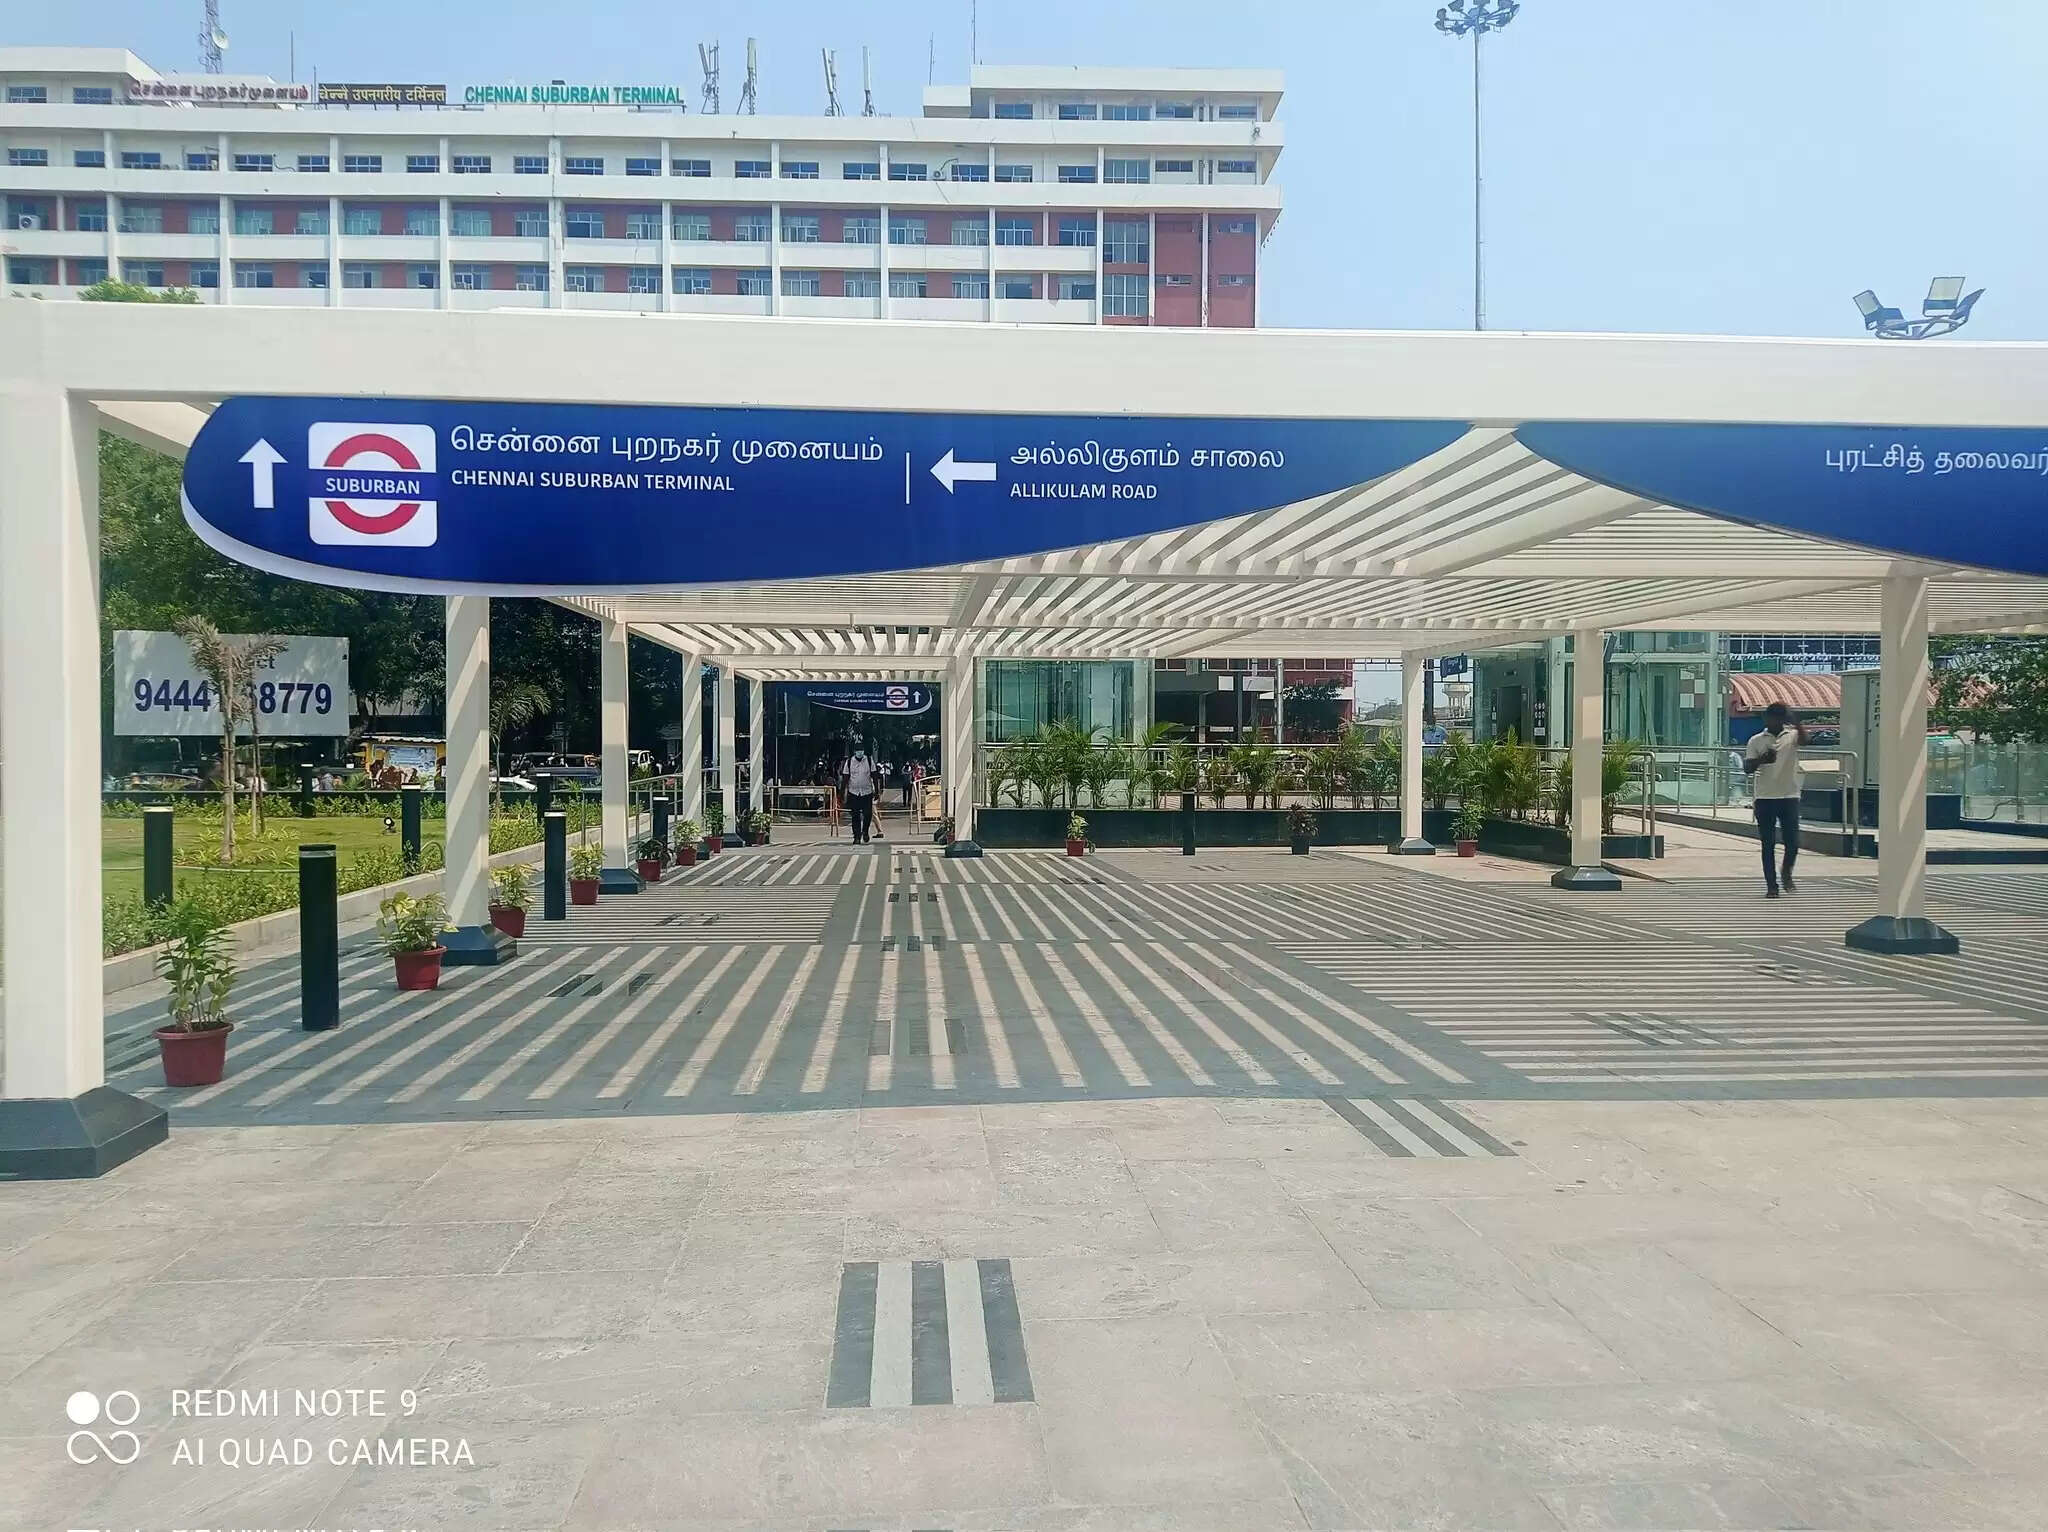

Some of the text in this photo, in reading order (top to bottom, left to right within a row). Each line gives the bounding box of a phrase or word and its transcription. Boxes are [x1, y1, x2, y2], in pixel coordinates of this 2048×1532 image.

[352, 86, 401, 102] उपनगरीय
[406, 86, 446, 102] टर्मिनल
[464, 86, 685, 105] CHENNAI SUBURBAN TERMINAL
[450, 425, 884, 464] சென்னை புறநகர் முனையம்
[1010, 440, 1285, 473] அல்லிகுளம் சாலை
[1825, 443, 1925, 475] புரட்சித்
[325, 477, 421, 495] SUBURBAN
[451, 470, 735, 491] CHENNAI SUBURBAN TERMINAL
[1010, 483, 1158, 500] ALLIKULAM ROAD
